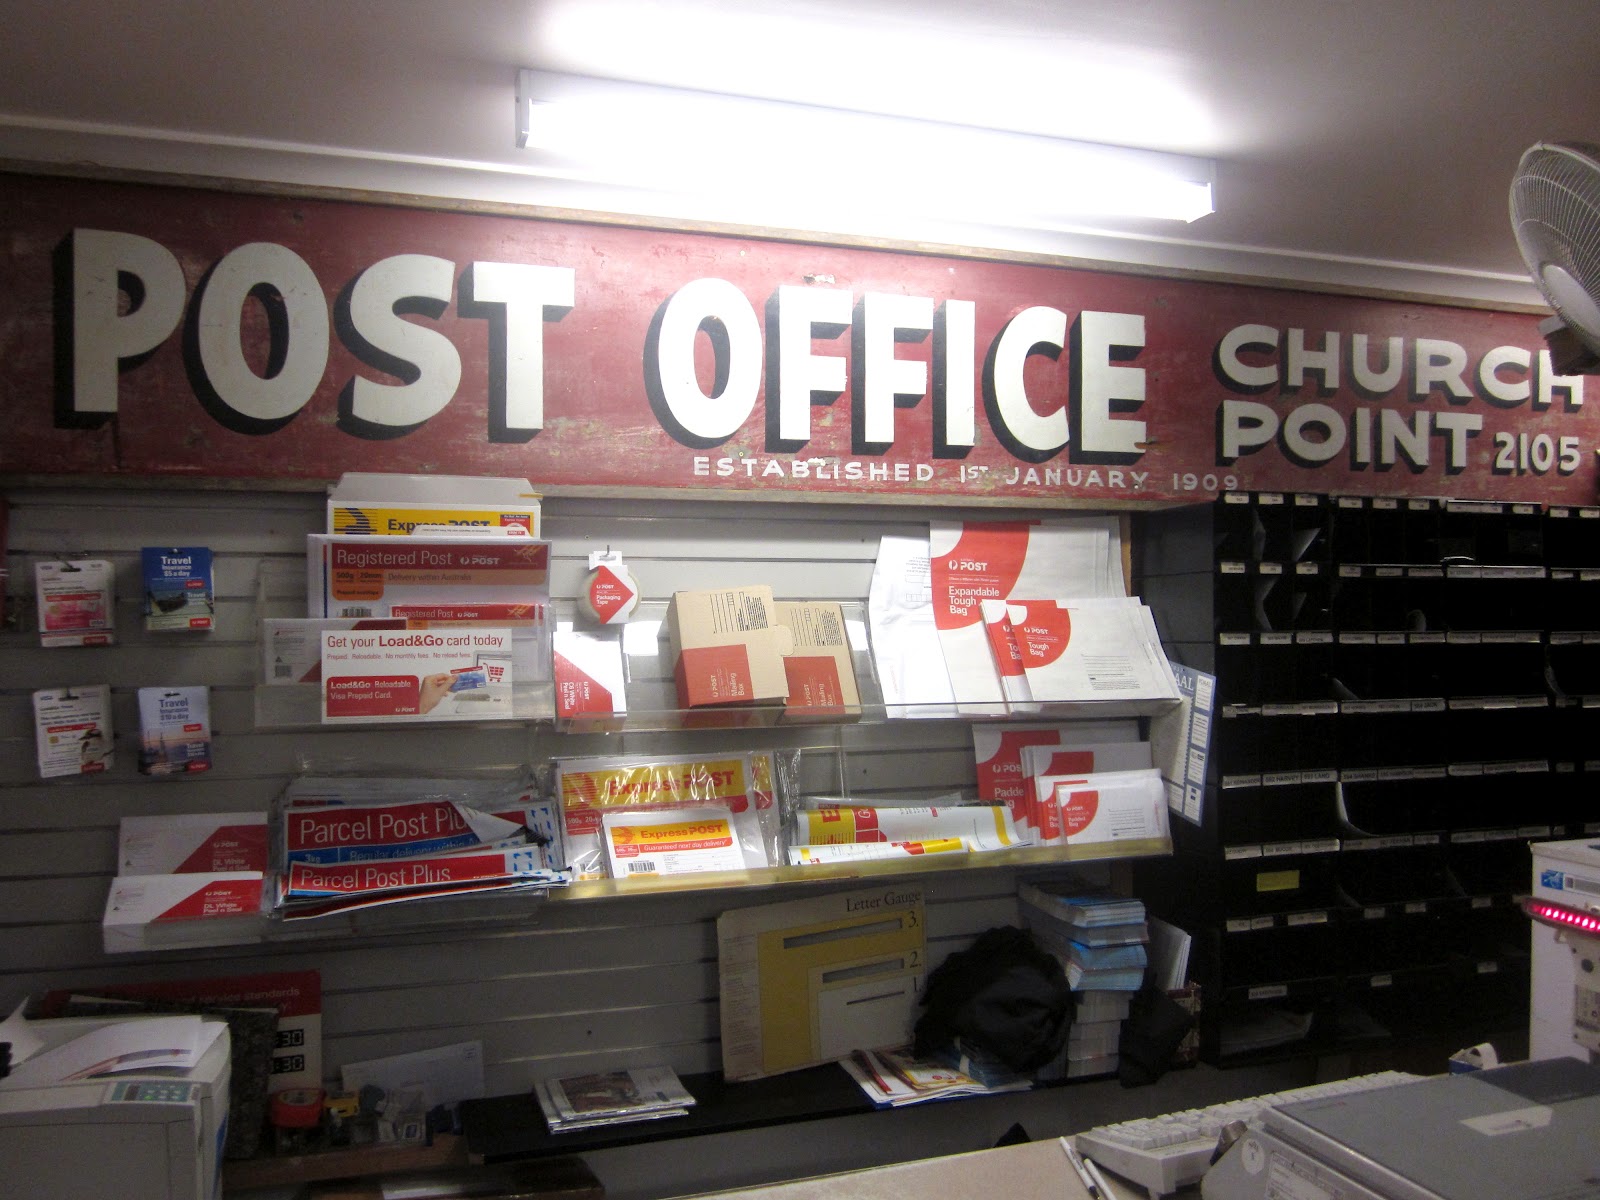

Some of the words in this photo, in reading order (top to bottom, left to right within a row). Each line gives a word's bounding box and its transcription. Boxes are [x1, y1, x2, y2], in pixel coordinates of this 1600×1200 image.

[66, 228, 576, 442] POST
[648, 277, 1147, 463] OFFICE
[1216, 323, 1585, 408] CHURCH
[1218, 400, 1483, 472] POINT
[1494, 432, 1581, 473] 2105
[693, 456, 935, 482] ESTABLISHED
[1006, 467, 1149, 488] JANUARY
[1172, 472, 1239, 491] 1909
[160, 555, 192, 566] Travel
[337, 550, 416, 568] Registered
[421, 551, 453, 566] Post
[471, 557, 500, 566] POST
[961, 561, 988, 571] POST
[948, 586, 1000, 597] Expandable
[948, 596, 977, 607] Tough
[395, 608, 436, 619] Registered
[437, 608, 454, 618] Post
[950, 605, 968, 616] Bag
[1030, 627, 1049, 635] POST
[327, 635, 347, 648] Get
[350, 637, 376, 650] your
[378, 634, 444, 648] Load&Go
[446, 634, 470, 647] card
[473, 634, 504, 648] today
[1027, 641, 1050, 651] Tough
[1029, 648, 1044, 658] Bag
[330, 680, 371, 689] Load&Go
[374, 680, 411, 689] Reloadable
[330, 692, 346, 700] Visa
[347, 691, 373, 701] Prepaid
[374, 690, 393, 700] Card.
[158, 697, 189, 708] Travel
[1003, 764, 1022, 773] POS
[994, 786, 1024, 798] Padde
[300, 815, 371, 845] Parcel
[379, 810, 429, 839] Post
[435, 806, 467, 832] Plu
[692, 841, 702, 849] day
[300, 869, 359, 889] Parcel
[365, 867, 407, 888] Post
[413, 864, 451, 884] Plus
[846, 897, 882, 912] Letter
[884, 892, 921, 907] Gauge
[244, 987, 300, 1000] standards
